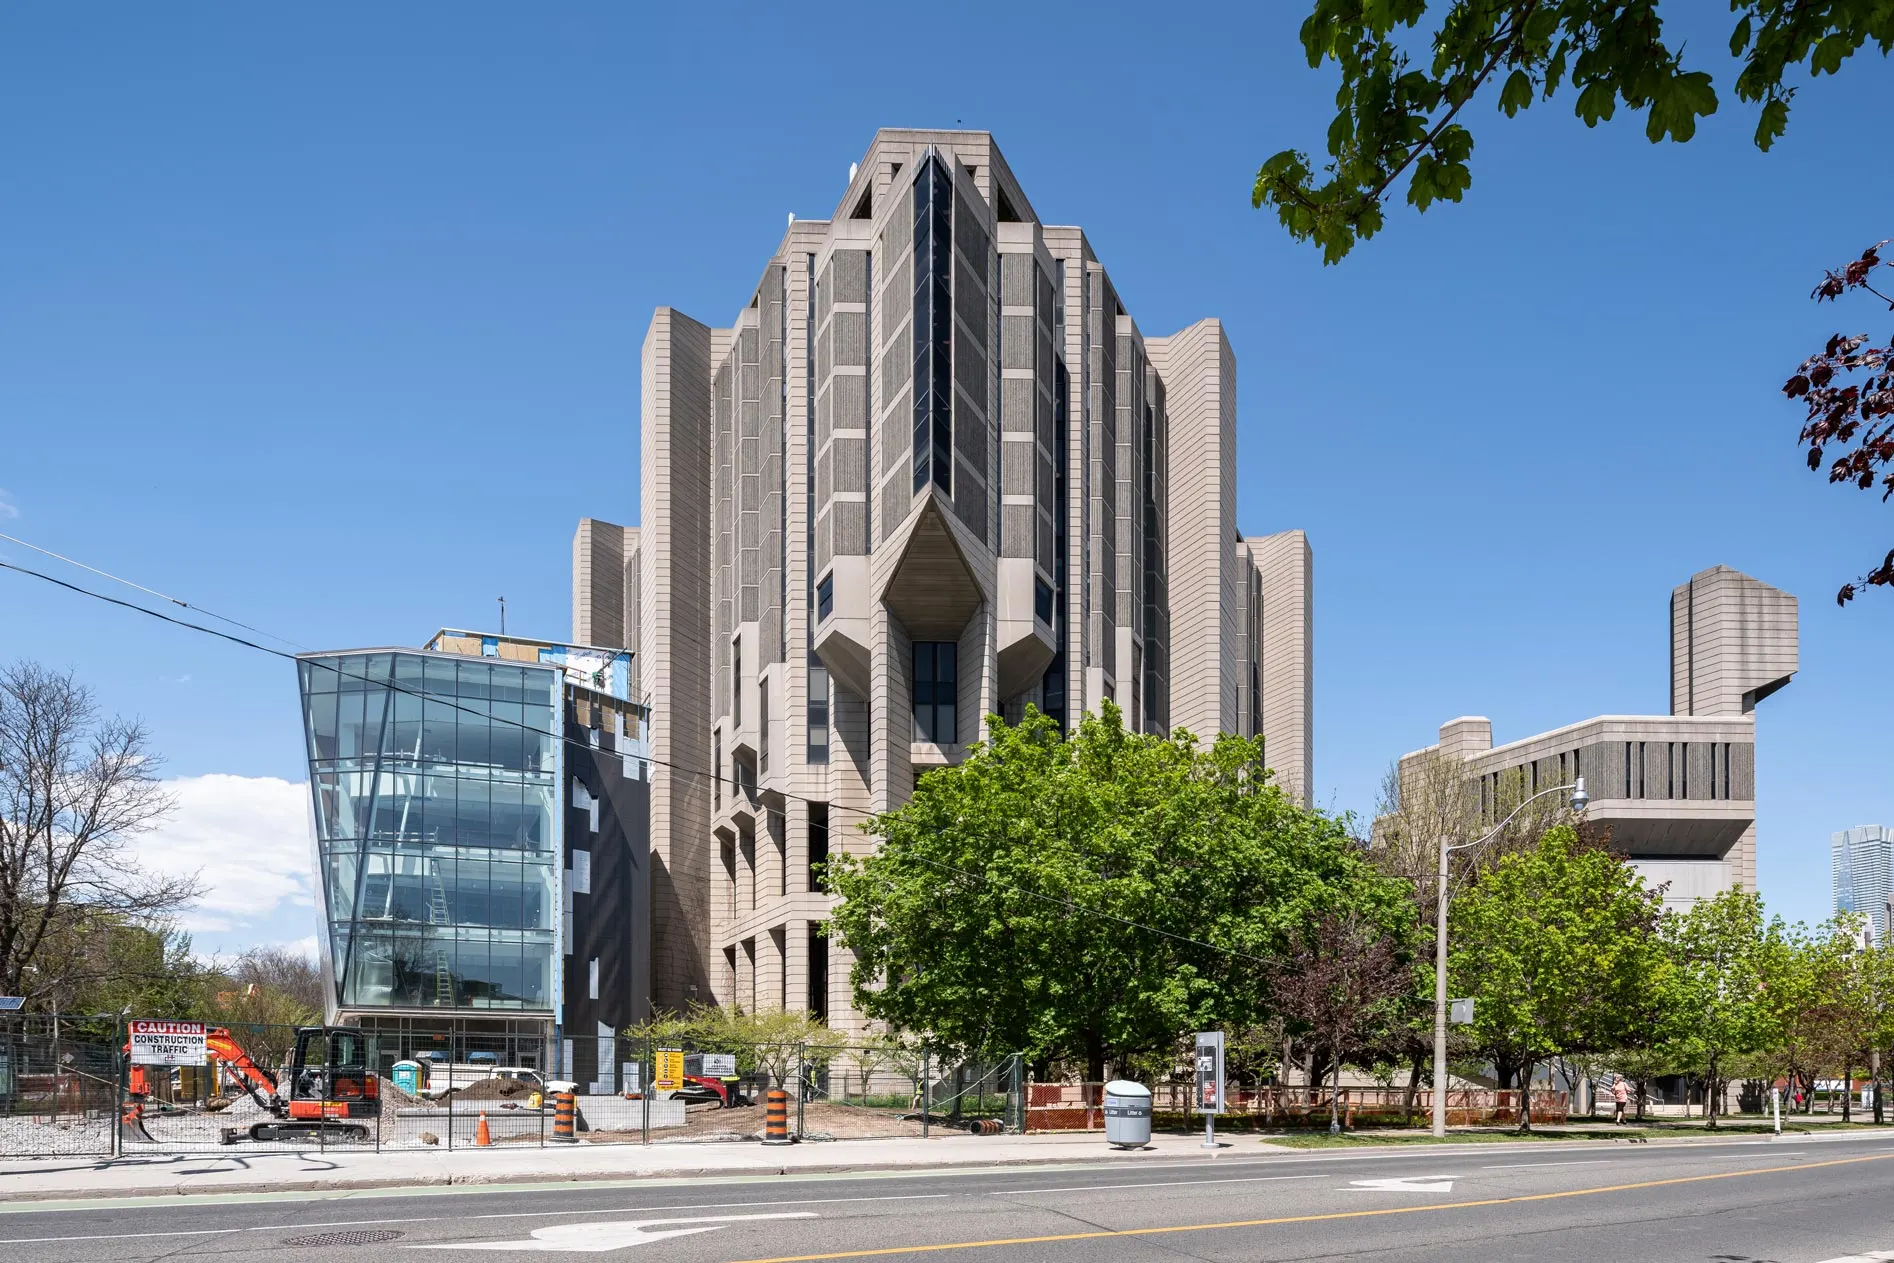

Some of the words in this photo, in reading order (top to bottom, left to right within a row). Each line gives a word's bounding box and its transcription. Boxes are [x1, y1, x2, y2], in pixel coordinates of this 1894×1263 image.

[137, 1022, 201, 1033] CAUTION
[134, 1035, 204, 1044] CONSTRUCTION
[151, 1045, 188, 1053] TRAFFIC
